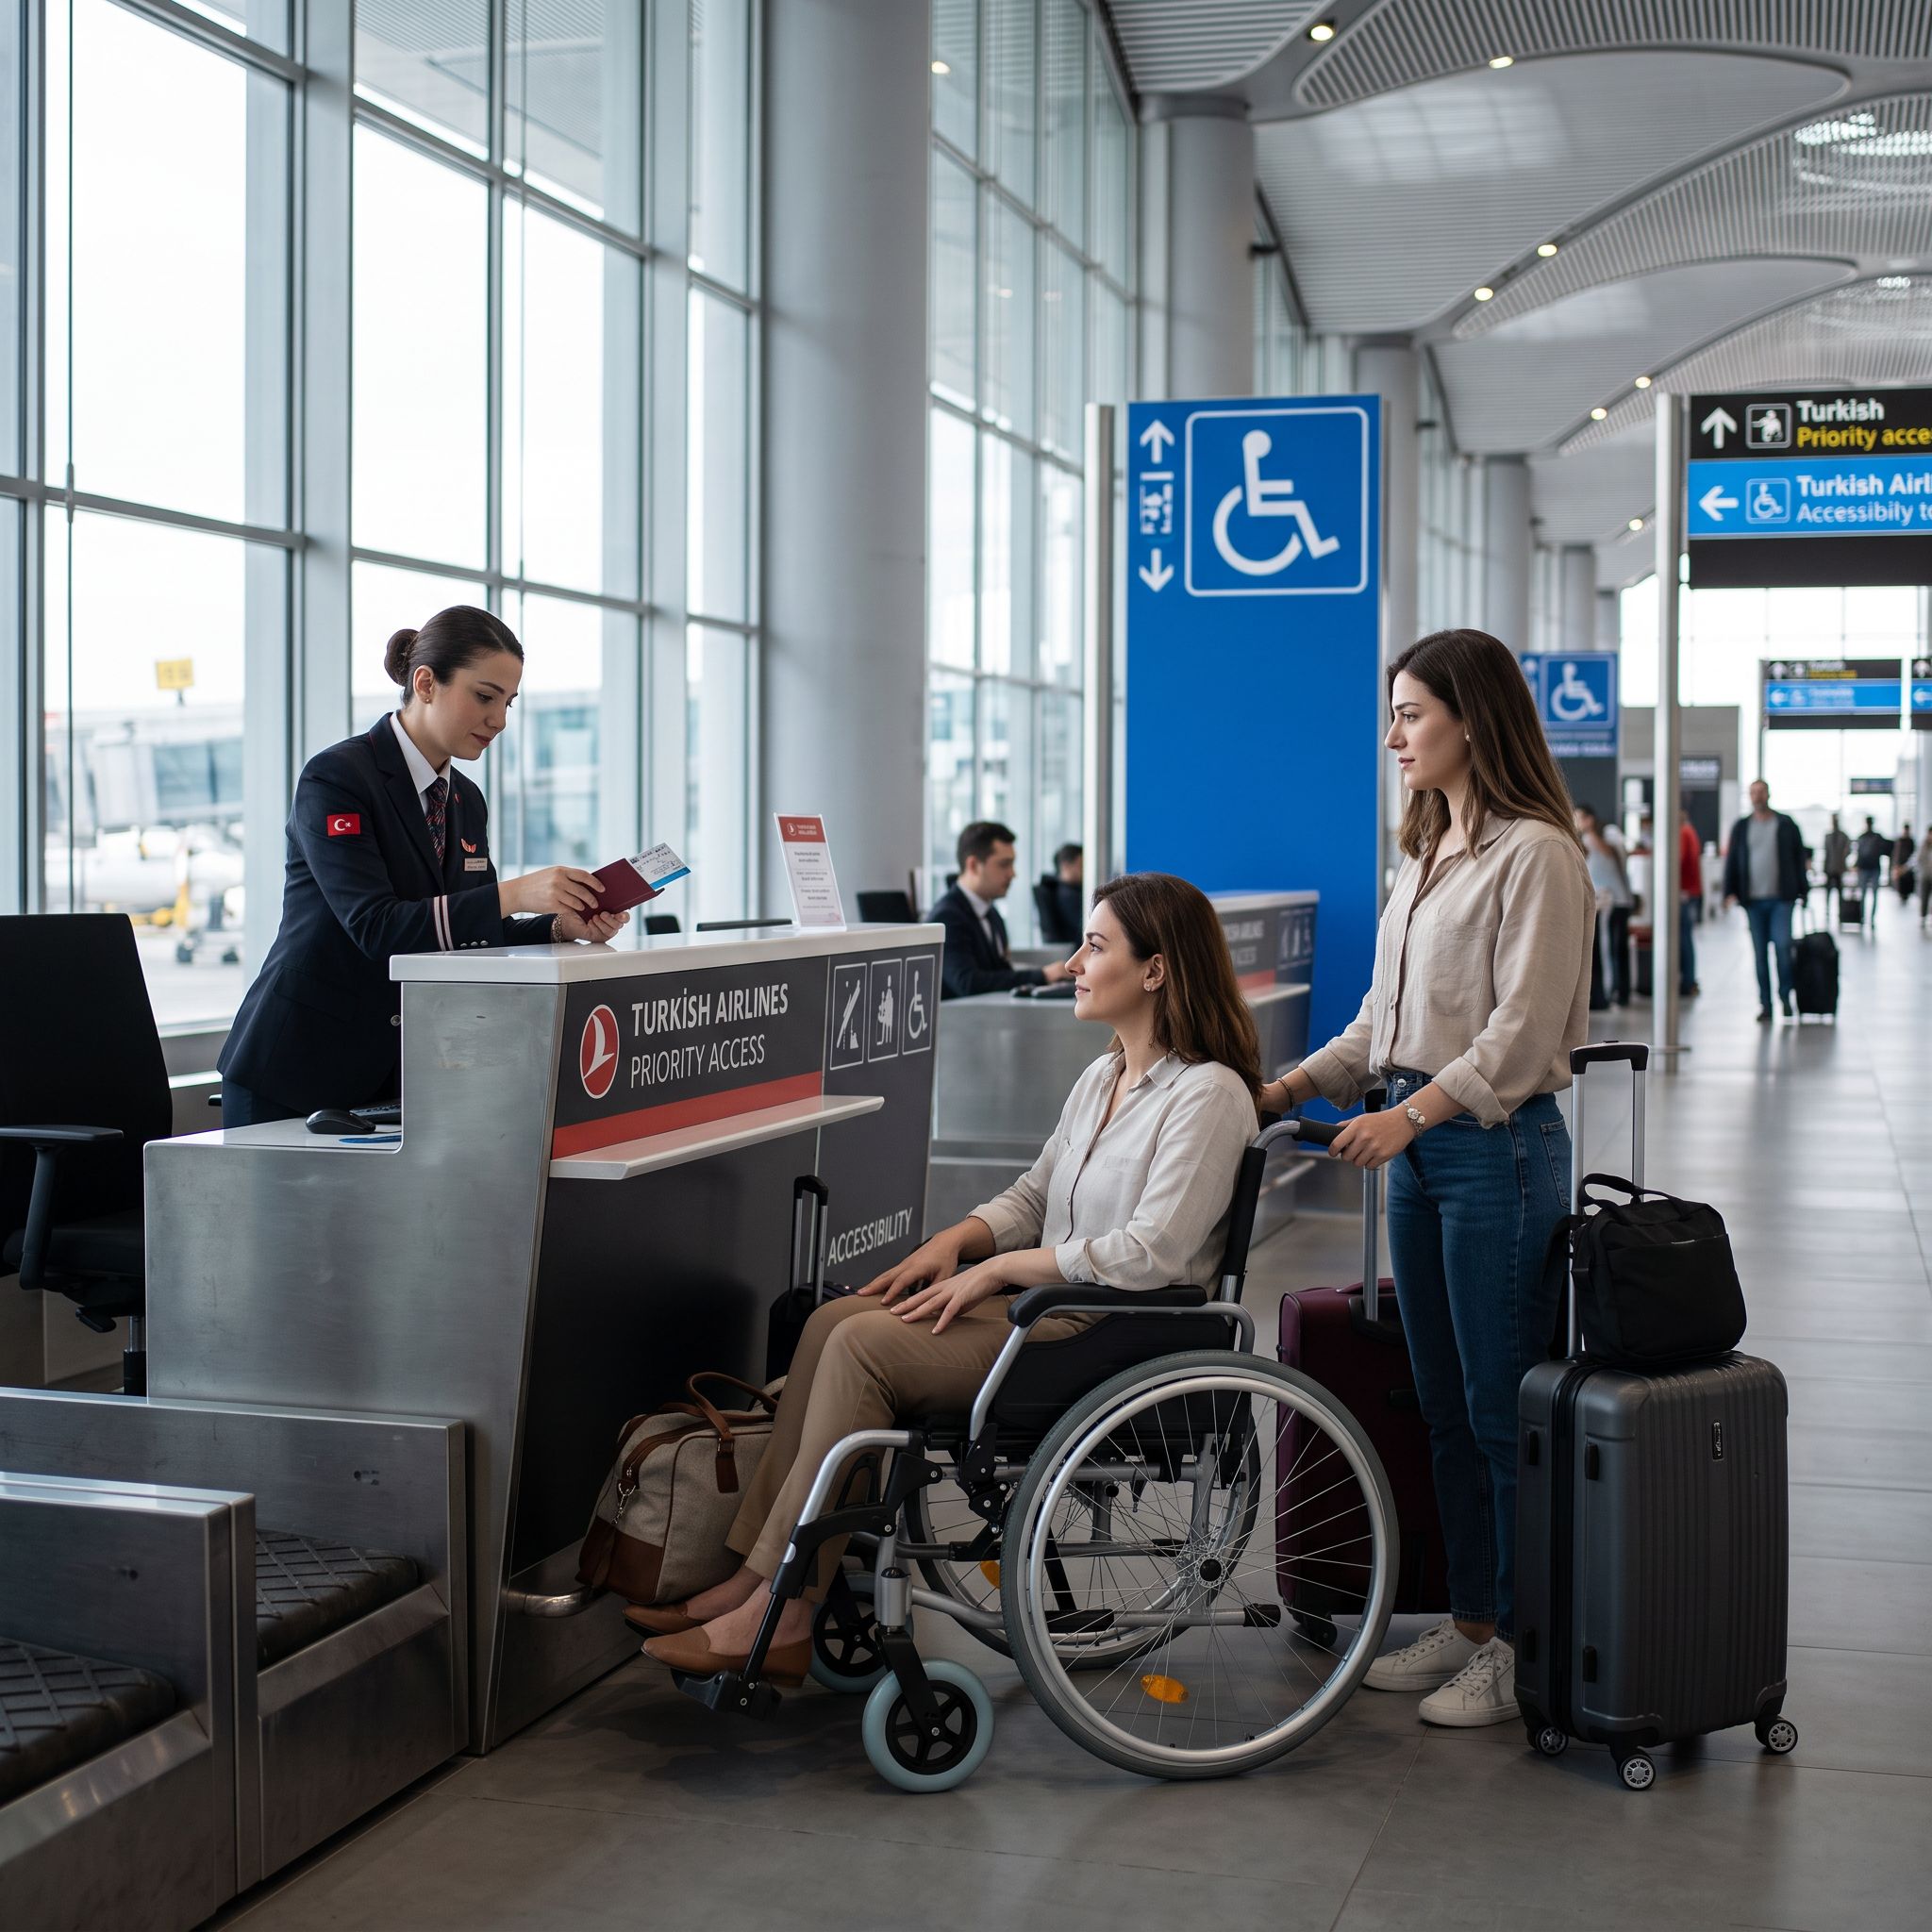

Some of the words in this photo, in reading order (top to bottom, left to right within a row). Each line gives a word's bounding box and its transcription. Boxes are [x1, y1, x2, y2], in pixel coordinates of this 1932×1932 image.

[1796, 398, 1885, 423] Turkish
[1797, 425, 1877, 452] Priority
[1882, 428, 1932, 446] acce
[1796, 474, 1884, 497] Turkish
[1796, 501, 1914, 527] Accessibily
[631, 988, 711, 1037] TURKİSH
[715, 983, 789, 1024] AIRLINES
[630, 1044, 706, 1089] PRIORITY
[708, 1033, 765, 1074] ACCESS
[827, 1207, 913, 1267] ACCESSIBILITY
